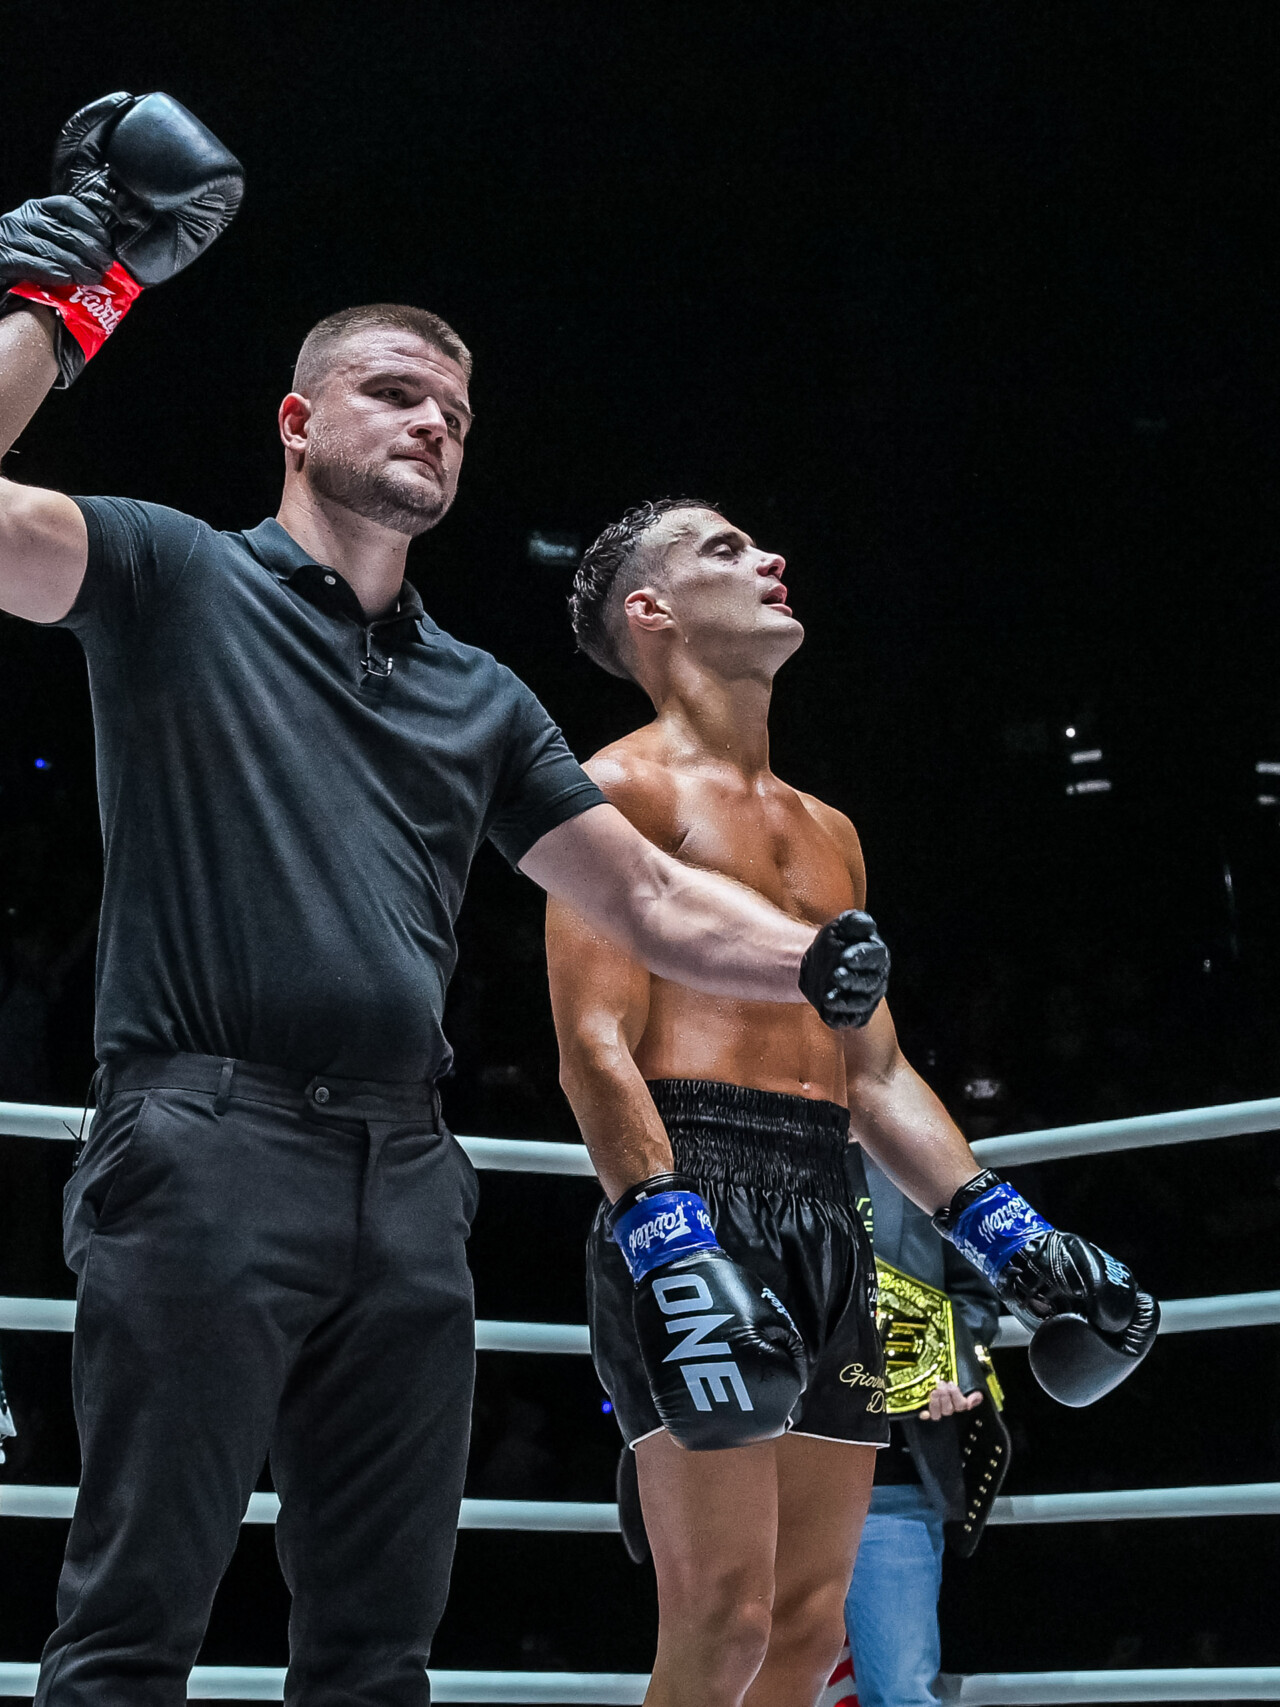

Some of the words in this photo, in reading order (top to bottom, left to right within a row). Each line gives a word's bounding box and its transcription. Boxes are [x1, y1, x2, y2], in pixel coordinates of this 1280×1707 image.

[69, 284, 122, 335] Fairt
[628, 1202, 692, 1257] Fairtex
[651, 1273, 754, 1412] ONE
